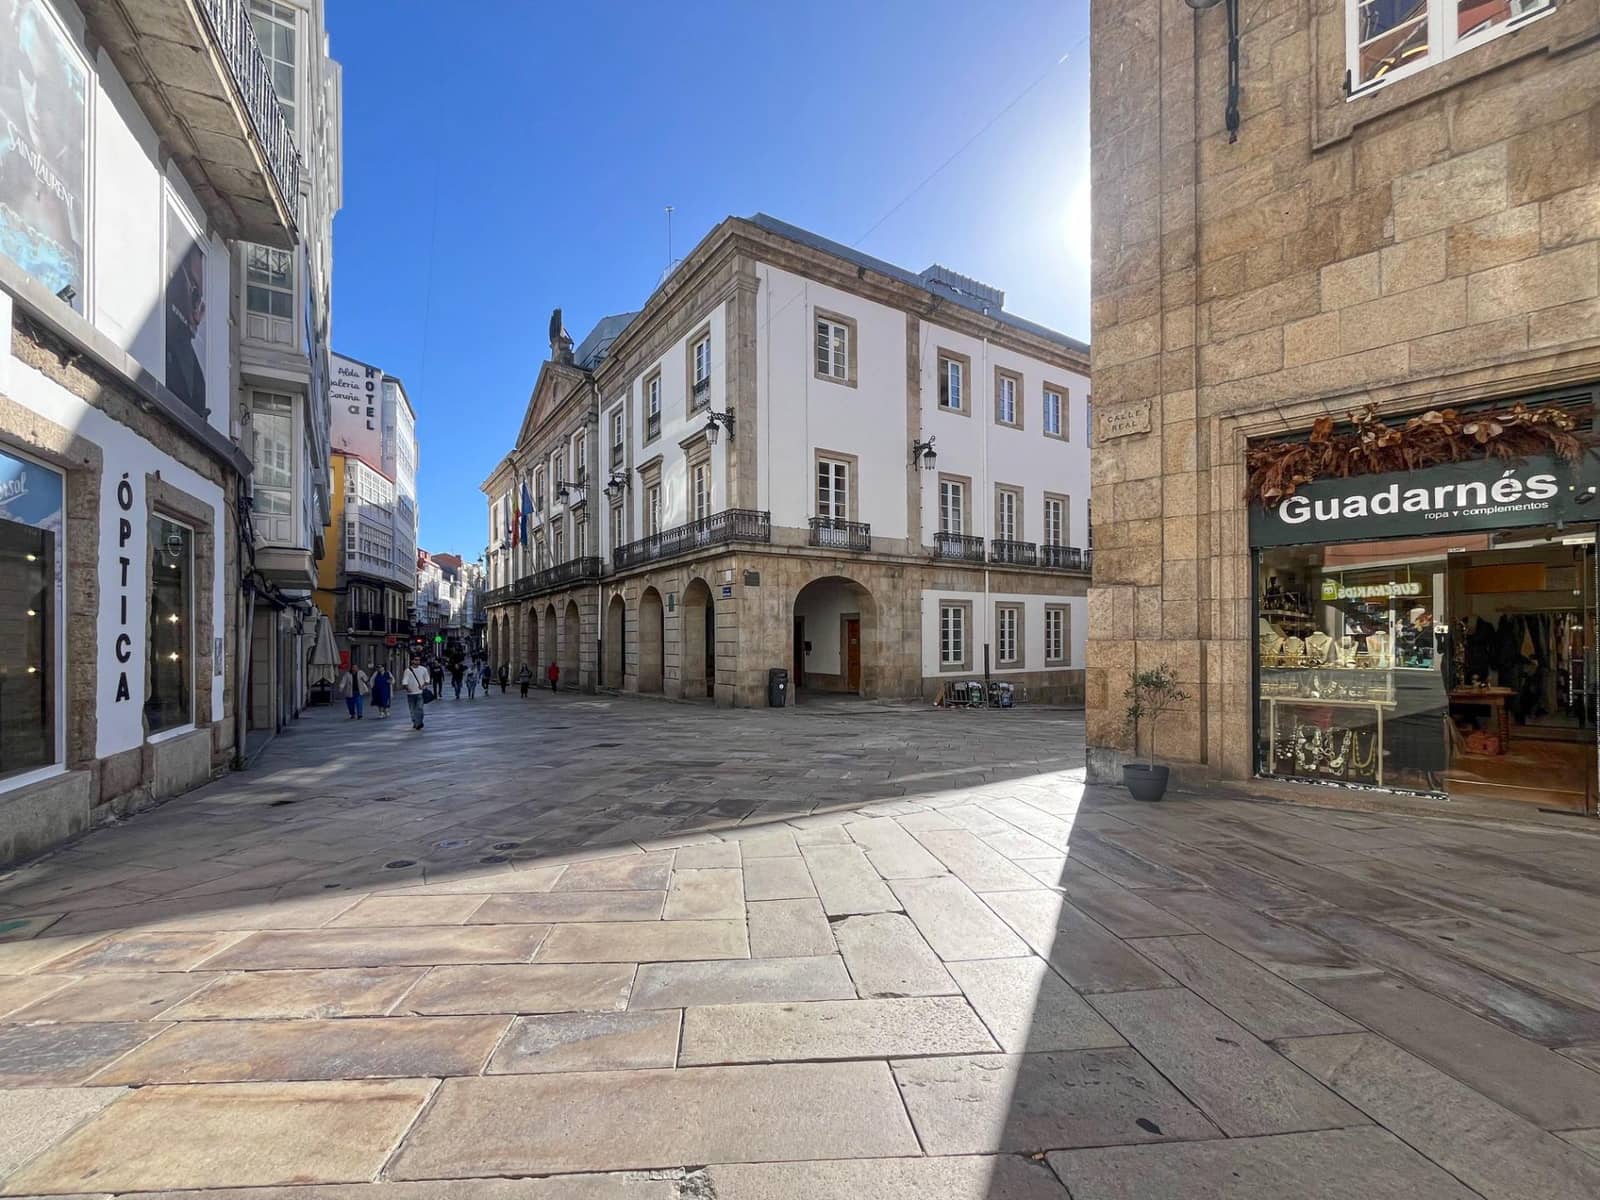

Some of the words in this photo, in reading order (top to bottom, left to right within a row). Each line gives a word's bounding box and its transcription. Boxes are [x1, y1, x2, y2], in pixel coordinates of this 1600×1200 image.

[365, 367, 375, 431] HOTEL
[1278, 469, 1559, 524] Guadarnés
[1424, 510, 1449, 520] ropa
[1462, 501, 1549, 516] complementos
[115, 472, 133, 703] ÓPTICA
